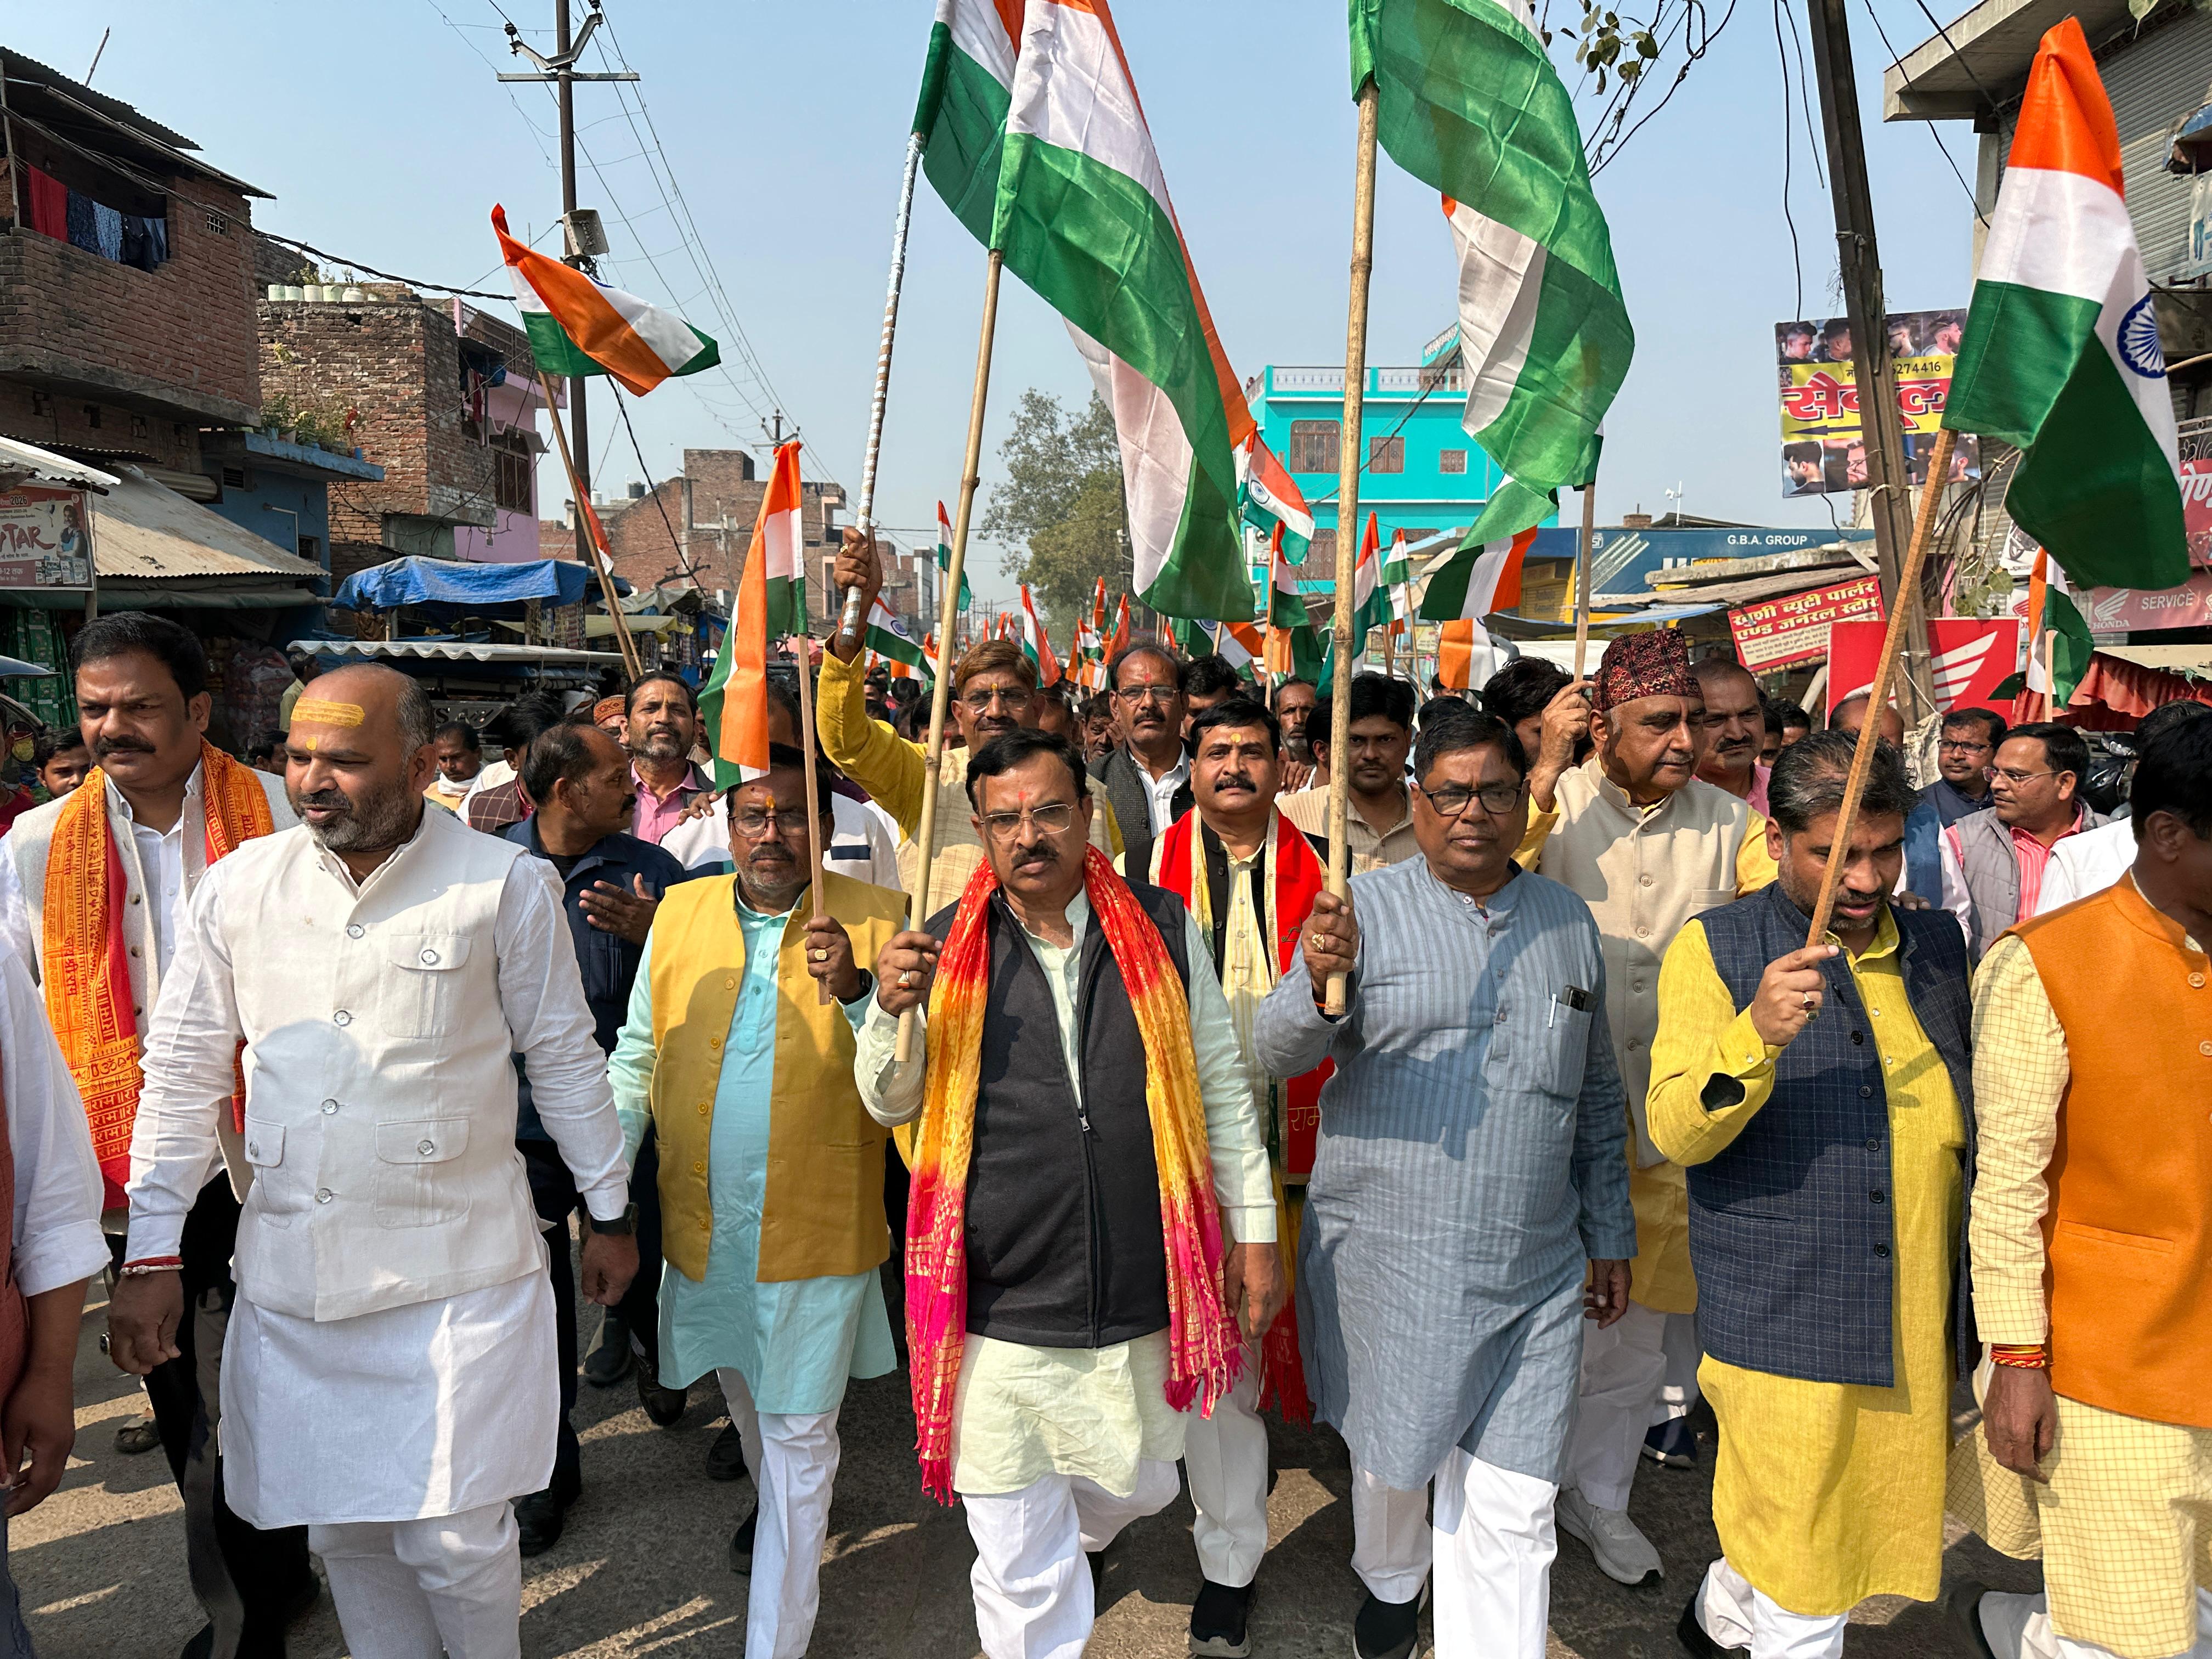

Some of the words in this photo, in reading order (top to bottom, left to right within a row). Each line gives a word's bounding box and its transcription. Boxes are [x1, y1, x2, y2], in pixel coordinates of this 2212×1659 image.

[10, 496, 27, 505] 2026
[1728, 535, 1762, 545] G.B.A.
[1765, 535, 1808, 545] GROUP
[1826, 581, 1875, 601] पार्लर
[2142, 592, 2193, 610] SERVICE
[1734, 623, 1773, 641] एण्ड
[1776, 607, 1836, 630] जनरल
[2093, 620, 2130, 629] HONDA
